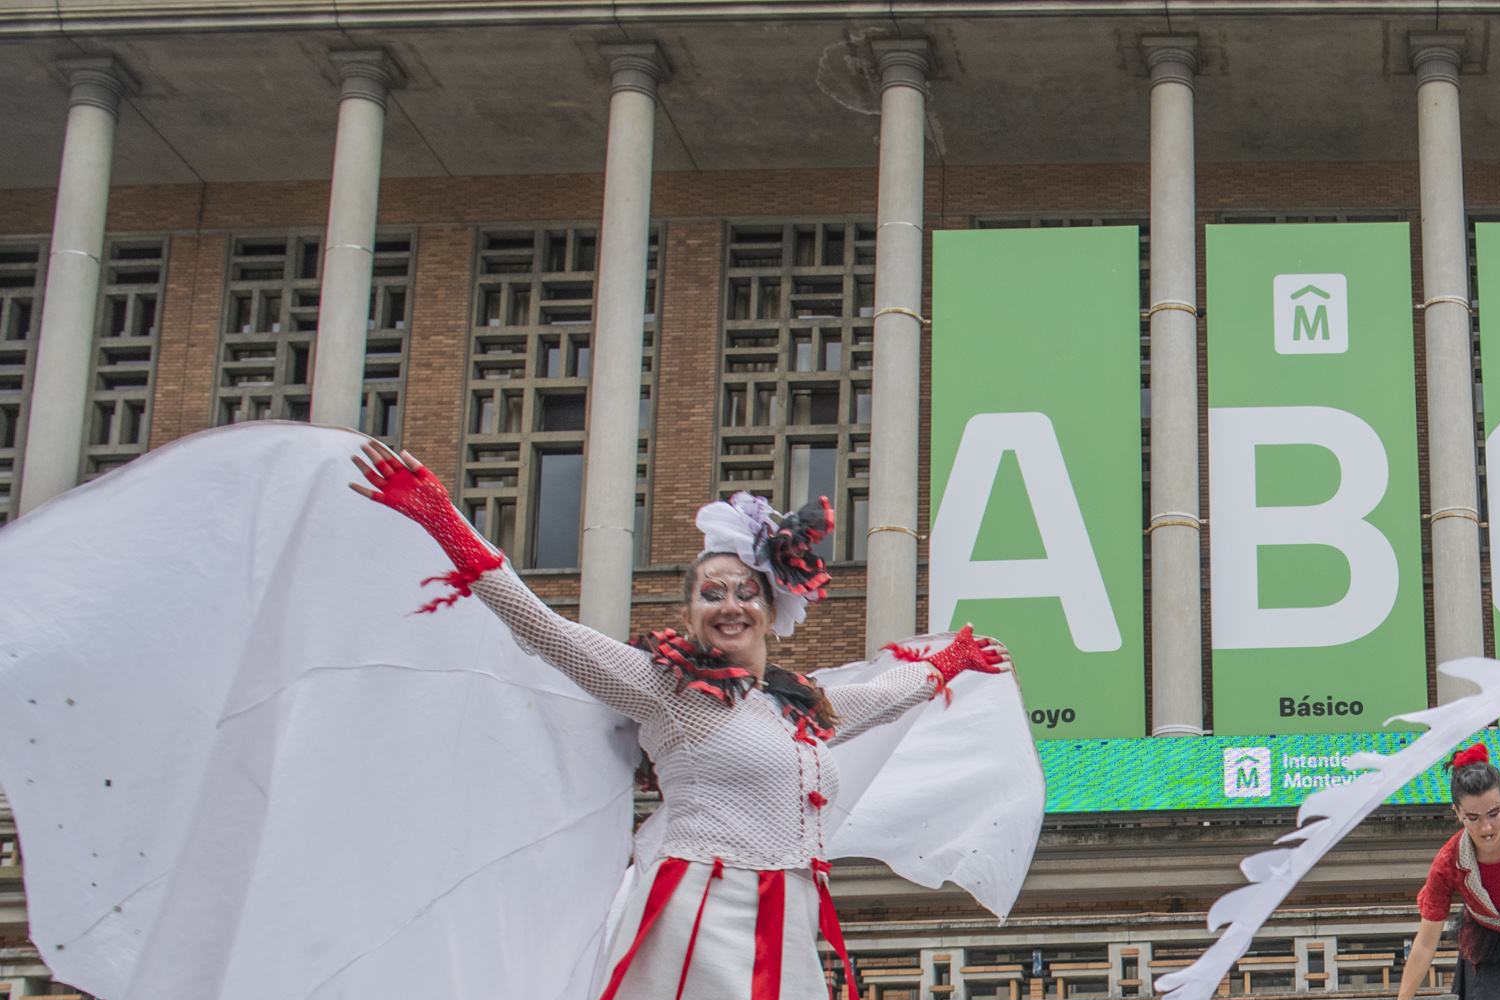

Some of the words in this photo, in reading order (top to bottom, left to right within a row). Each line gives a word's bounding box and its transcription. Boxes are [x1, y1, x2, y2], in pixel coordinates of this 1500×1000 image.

[1293, 304, 1330, 341] M
[929, 411, 1123, 653] A
[1208, 405, 1400, 650] B
[1279, 694, 1364, 717] Básico
